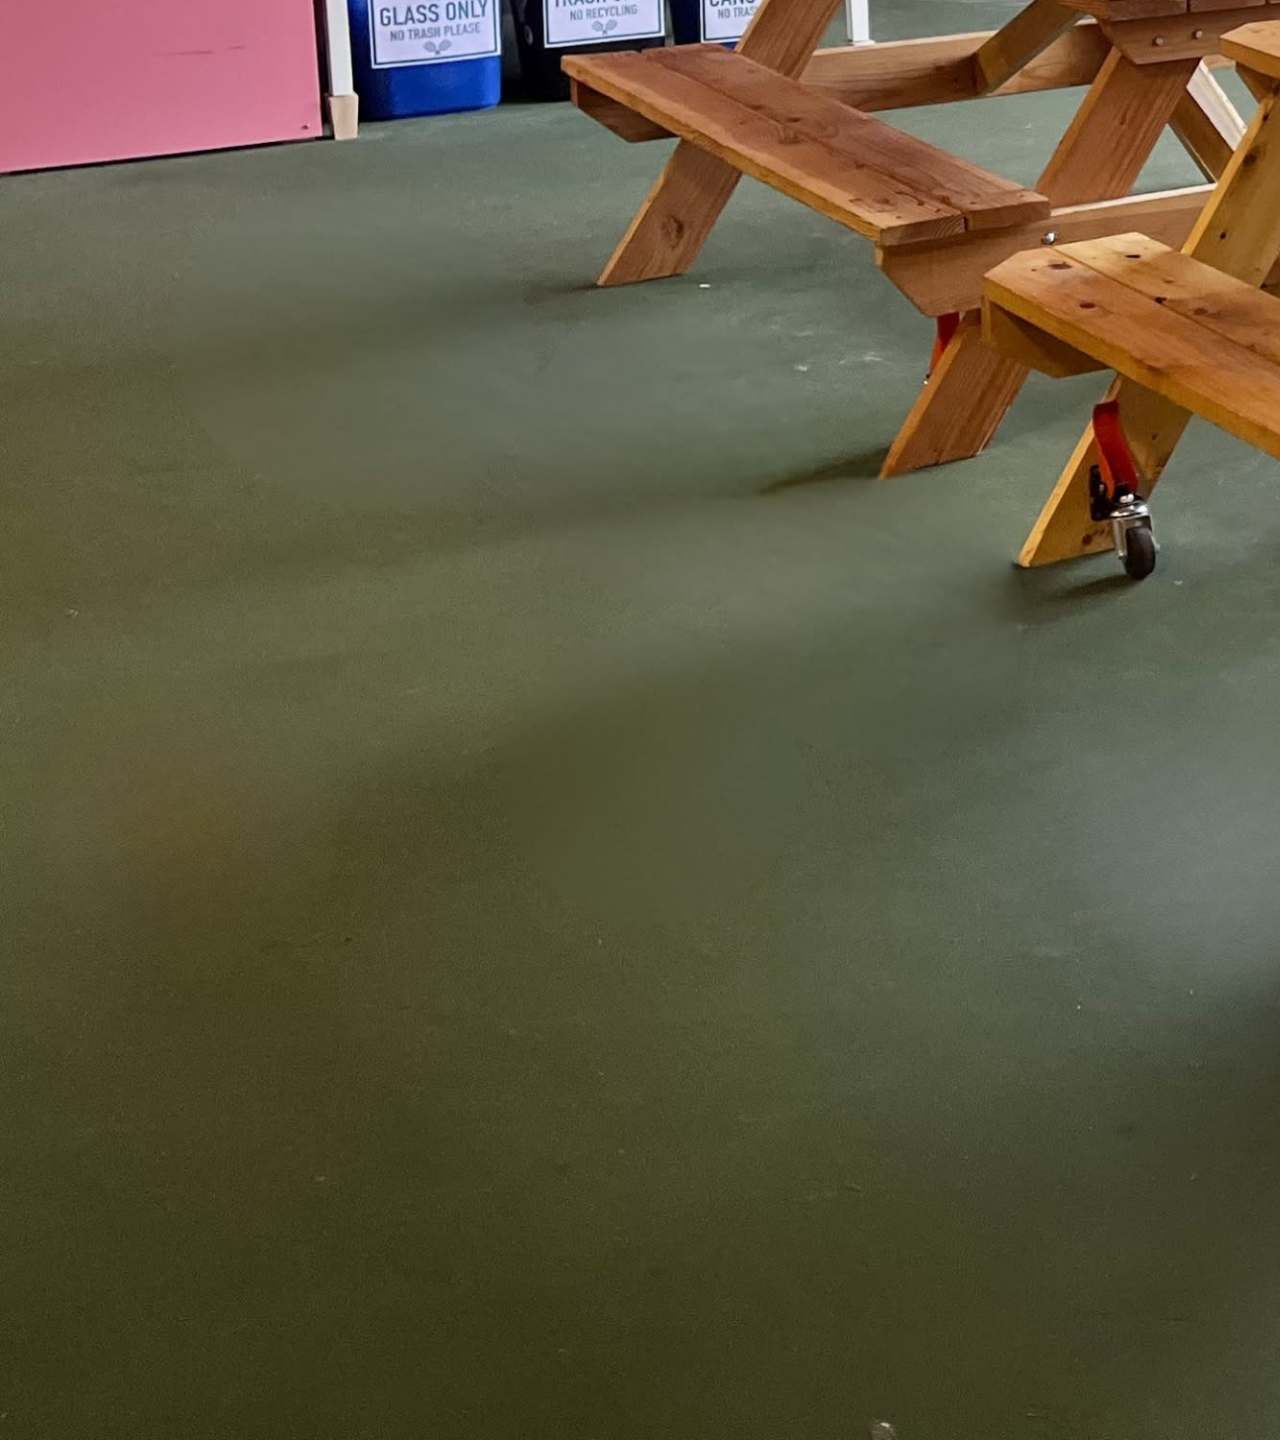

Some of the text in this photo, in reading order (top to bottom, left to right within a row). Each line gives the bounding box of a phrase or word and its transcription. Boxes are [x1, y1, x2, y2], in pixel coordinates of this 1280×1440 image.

[380, 3, 440, 27] GLASS
[570, 4, 638, 21] NO RECYCLING
[718, 8, 731, 19] NO
[390, 21, 480, 41] NO TRASH PLEASE
